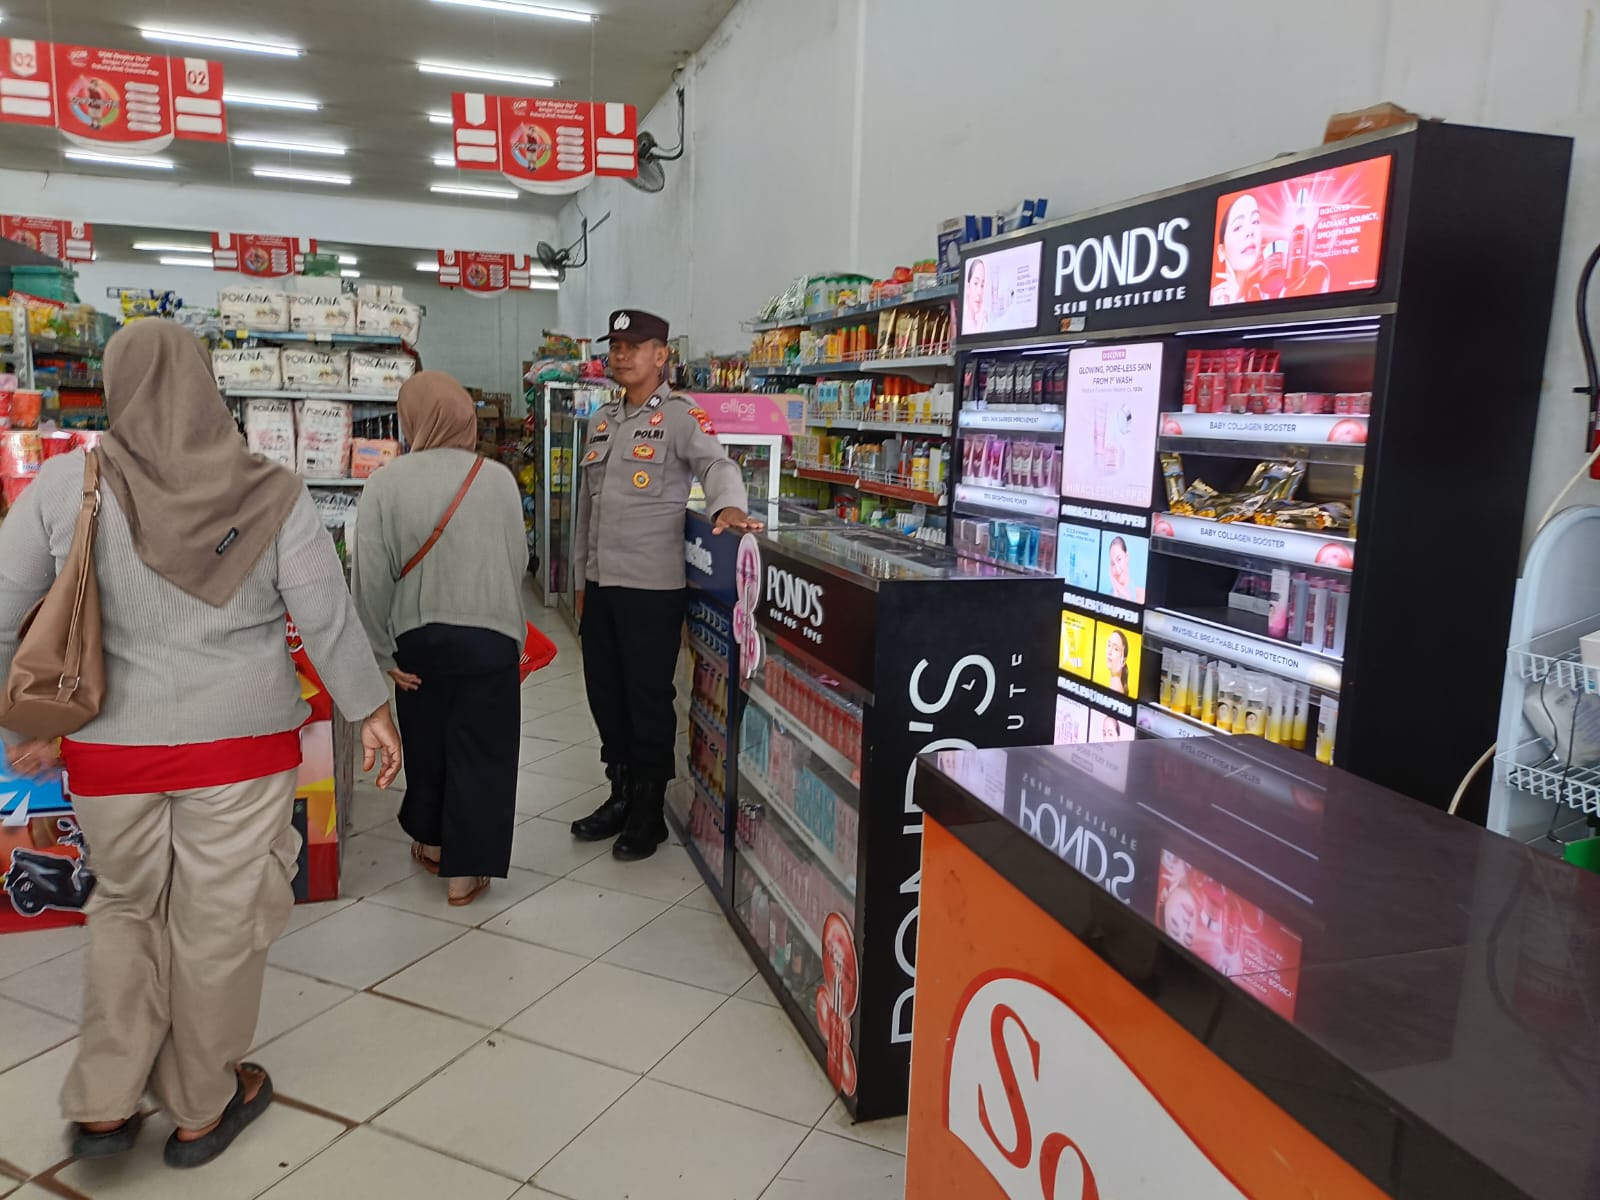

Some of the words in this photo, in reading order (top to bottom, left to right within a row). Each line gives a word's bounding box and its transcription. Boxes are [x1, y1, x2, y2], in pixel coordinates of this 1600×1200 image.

[187, 70, 207, 86] 02
[1054, 217, 1191, 297] POND'S
[1053, 300, 1088, 316] SKIN
[1095, 286, 1188, 310] INSTITUTE
[1138, 363, 1152, 372] SKIN
[1116, 376, 1133, 384] WASH
[720, 398, 756, 417] ellips
[633, 429, 664, 440] POLRI
[1209, 421, 1226, 430] BABY
[1227, 422, 1262, 431] COLLAGEN
[1264, 423, 1297, 432] BOOSTER
[1061, 504, 1103, 520] MIRACLES
[1107, 511, 1147, 528] HAPPEN
[1200, 527, 1217, 538] BABY
[1218, 530, 1251, 544] COLLAGEN
[1252, 536, 1285, 549] BOOSTER
[767, 565, 823, 627] POND'S
[1240, 644, 1254, 655] SUN
[1255, 648, 1299, 669] PROTECTION
